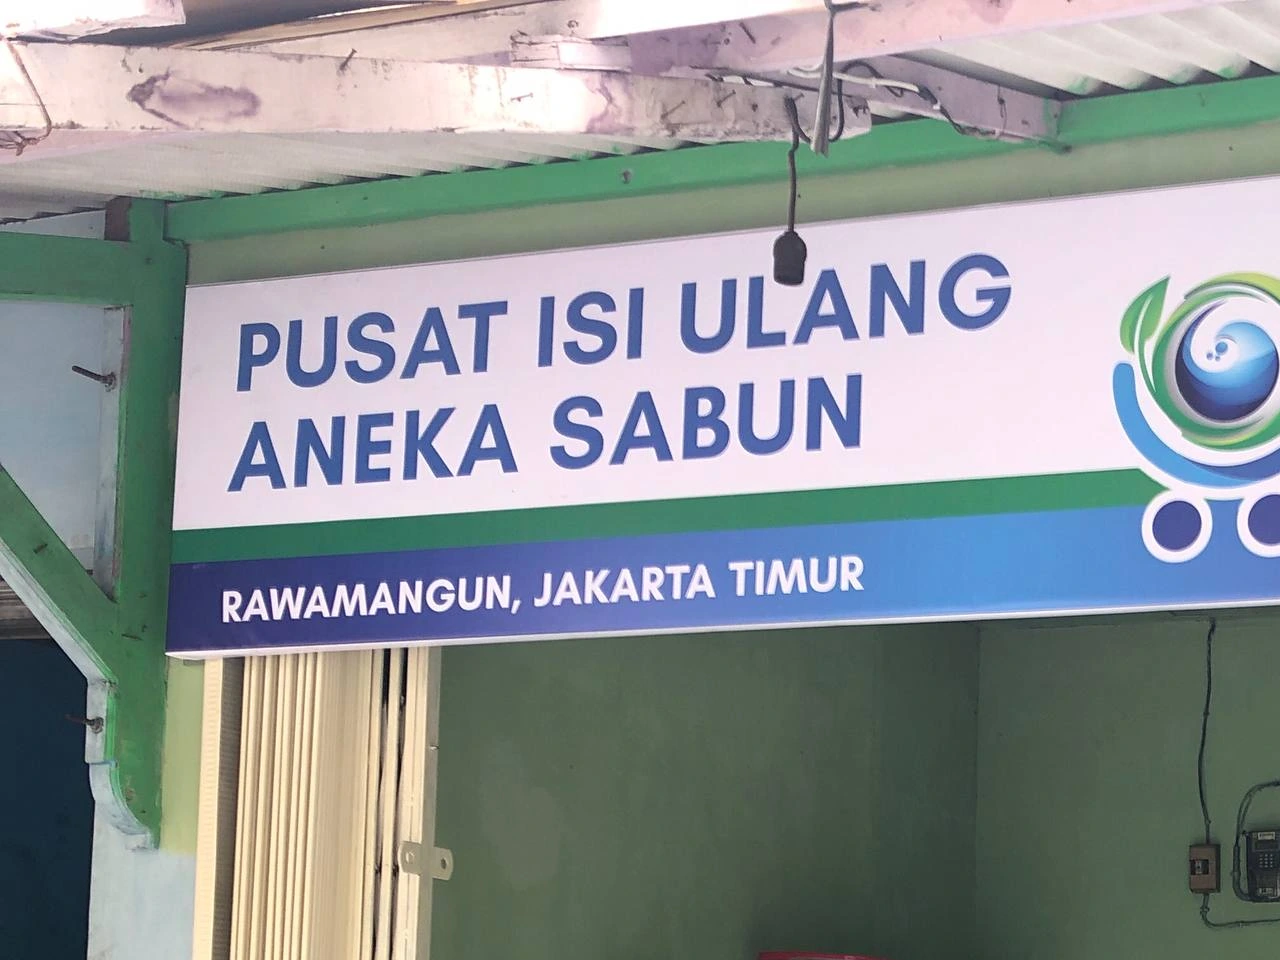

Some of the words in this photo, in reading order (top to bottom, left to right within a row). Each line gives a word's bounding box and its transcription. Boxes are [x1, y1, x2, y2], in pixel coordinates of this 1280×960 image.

[236, 300, 510, 393] PUSAT
[537, 287, 644, 369] ISI
[680, 252, 1013, 354] ULANG
[227, 402, 519, 493] ANEKA
[550, 373, 864, 470] SABUN
[221, 573, 521, 624] RAWAMANGUN,
[533, 562, 717, 608] JAKARTA
[729, 554, 865, 599] TIMUR
